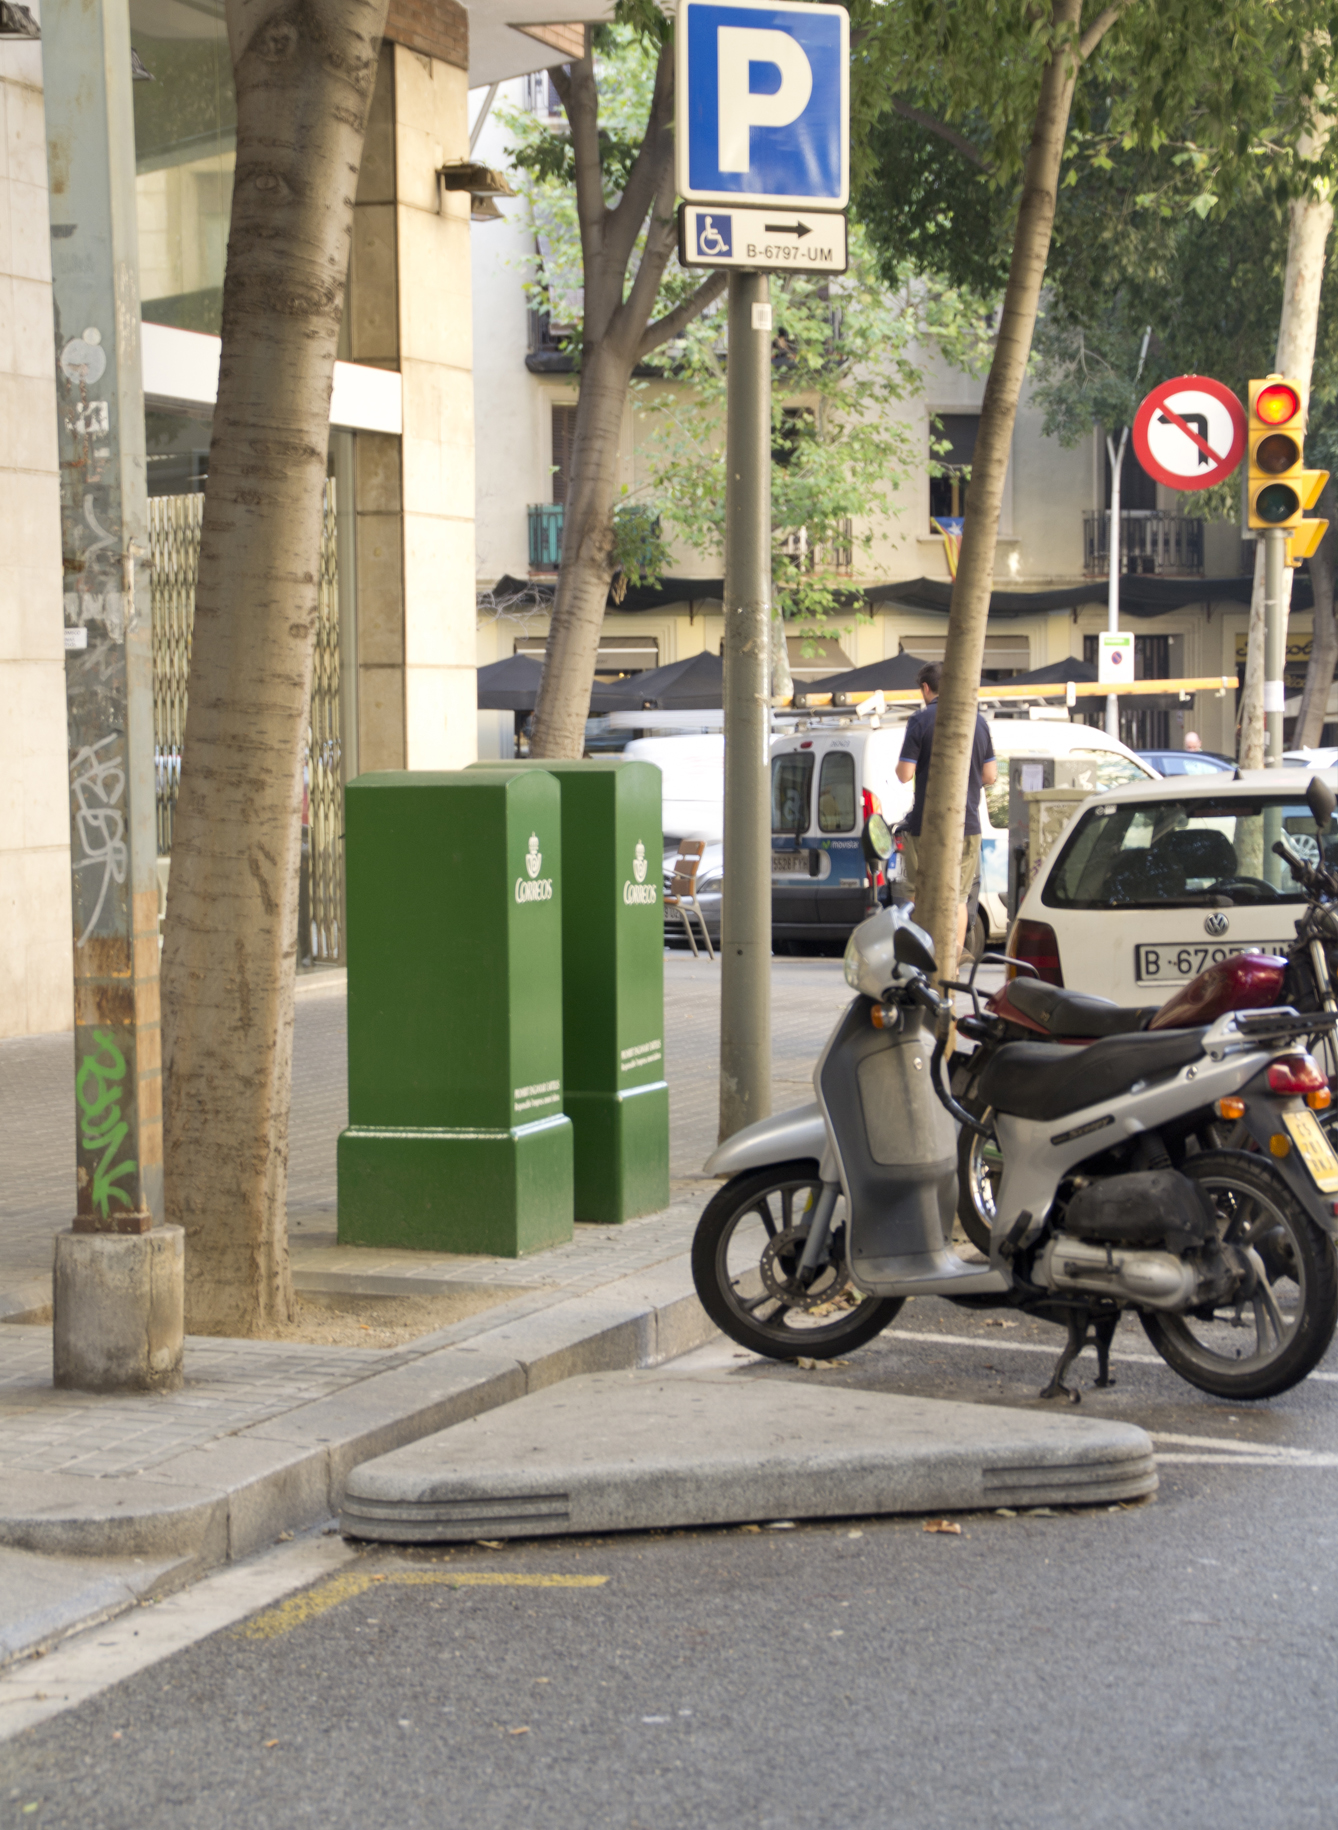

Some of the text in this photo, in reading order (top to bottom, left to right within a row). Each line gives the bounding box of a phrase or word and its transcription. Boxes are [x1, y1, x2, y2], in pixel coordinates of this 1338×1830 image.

[717, 25, 813, 173] P
[746, 243, 833, 262] B-6797-UM
[831, 841, 859, 849] movistar
